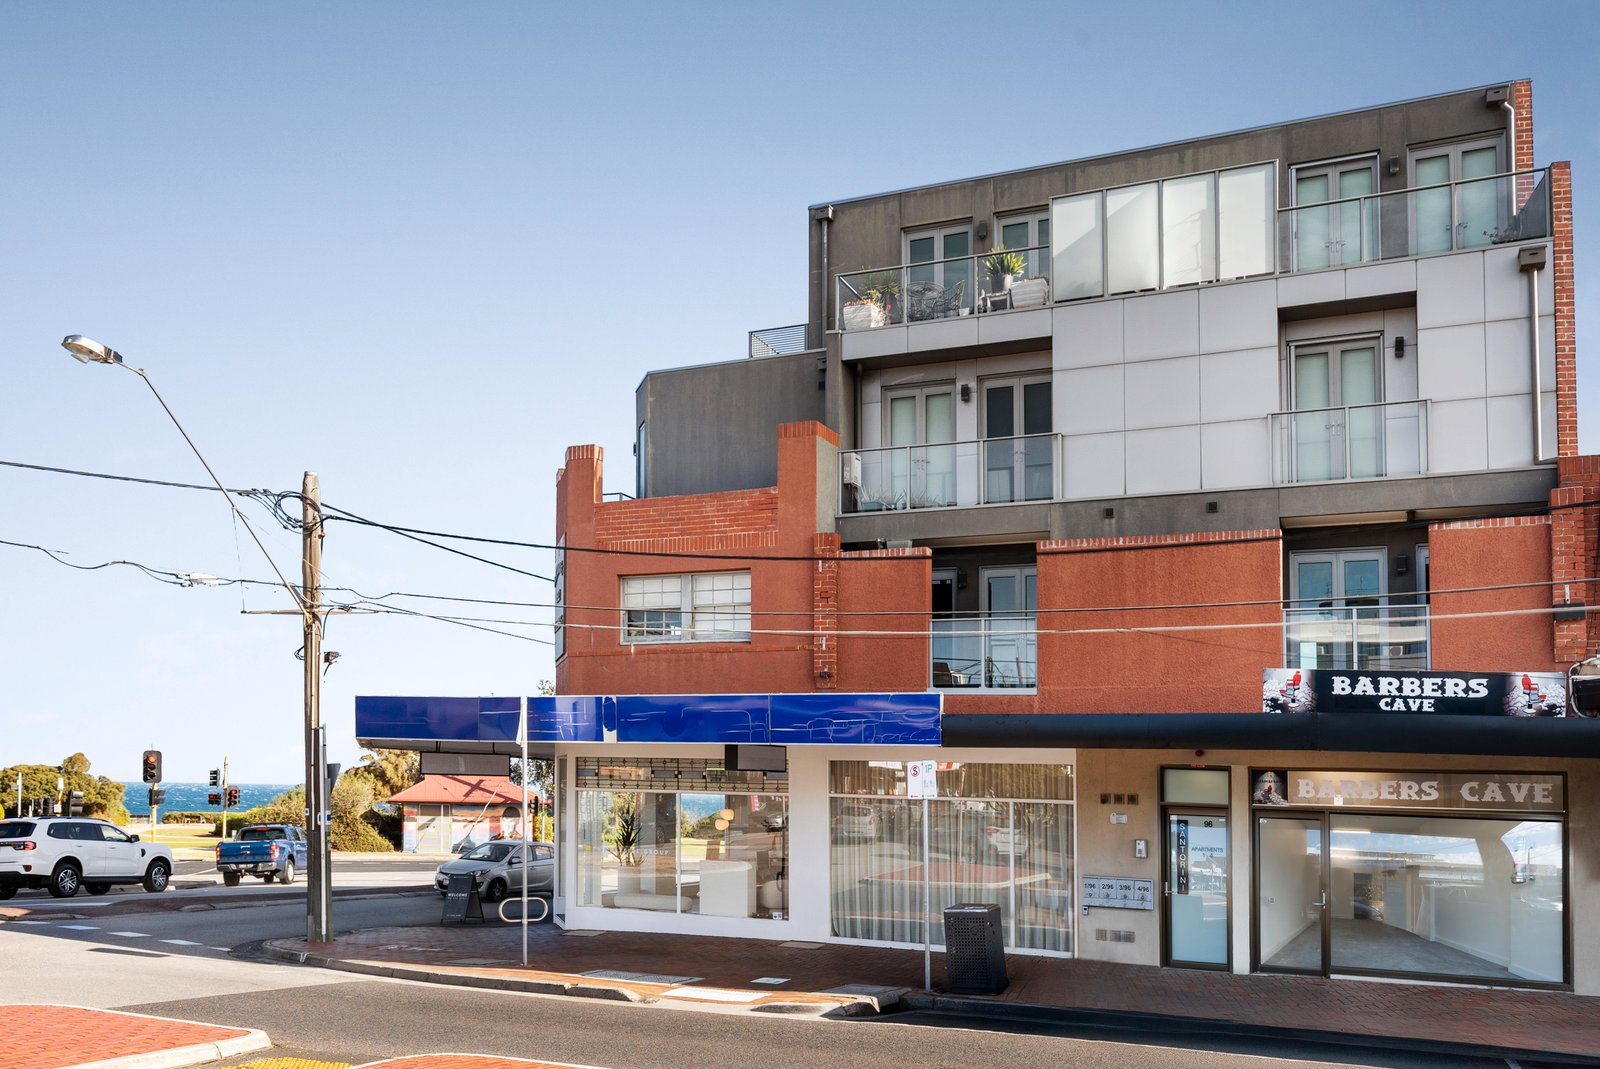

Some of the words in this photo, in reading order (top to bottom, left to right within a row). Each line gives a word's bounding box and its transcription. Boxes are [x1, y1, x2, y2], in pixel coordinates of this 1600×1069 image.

[1331, 676, 1489, 698] BARBERS
[1378, 698, 1435, 712] CAVE
[925, 764, 933, 773] 1P
[1297, 778, 1440, 801] BARBERS
[1460, 781, 1553, 804] CAVE
[1203, 820, 1213, 828] 96
[1179, 823, 1187, 891] SANTORINI
